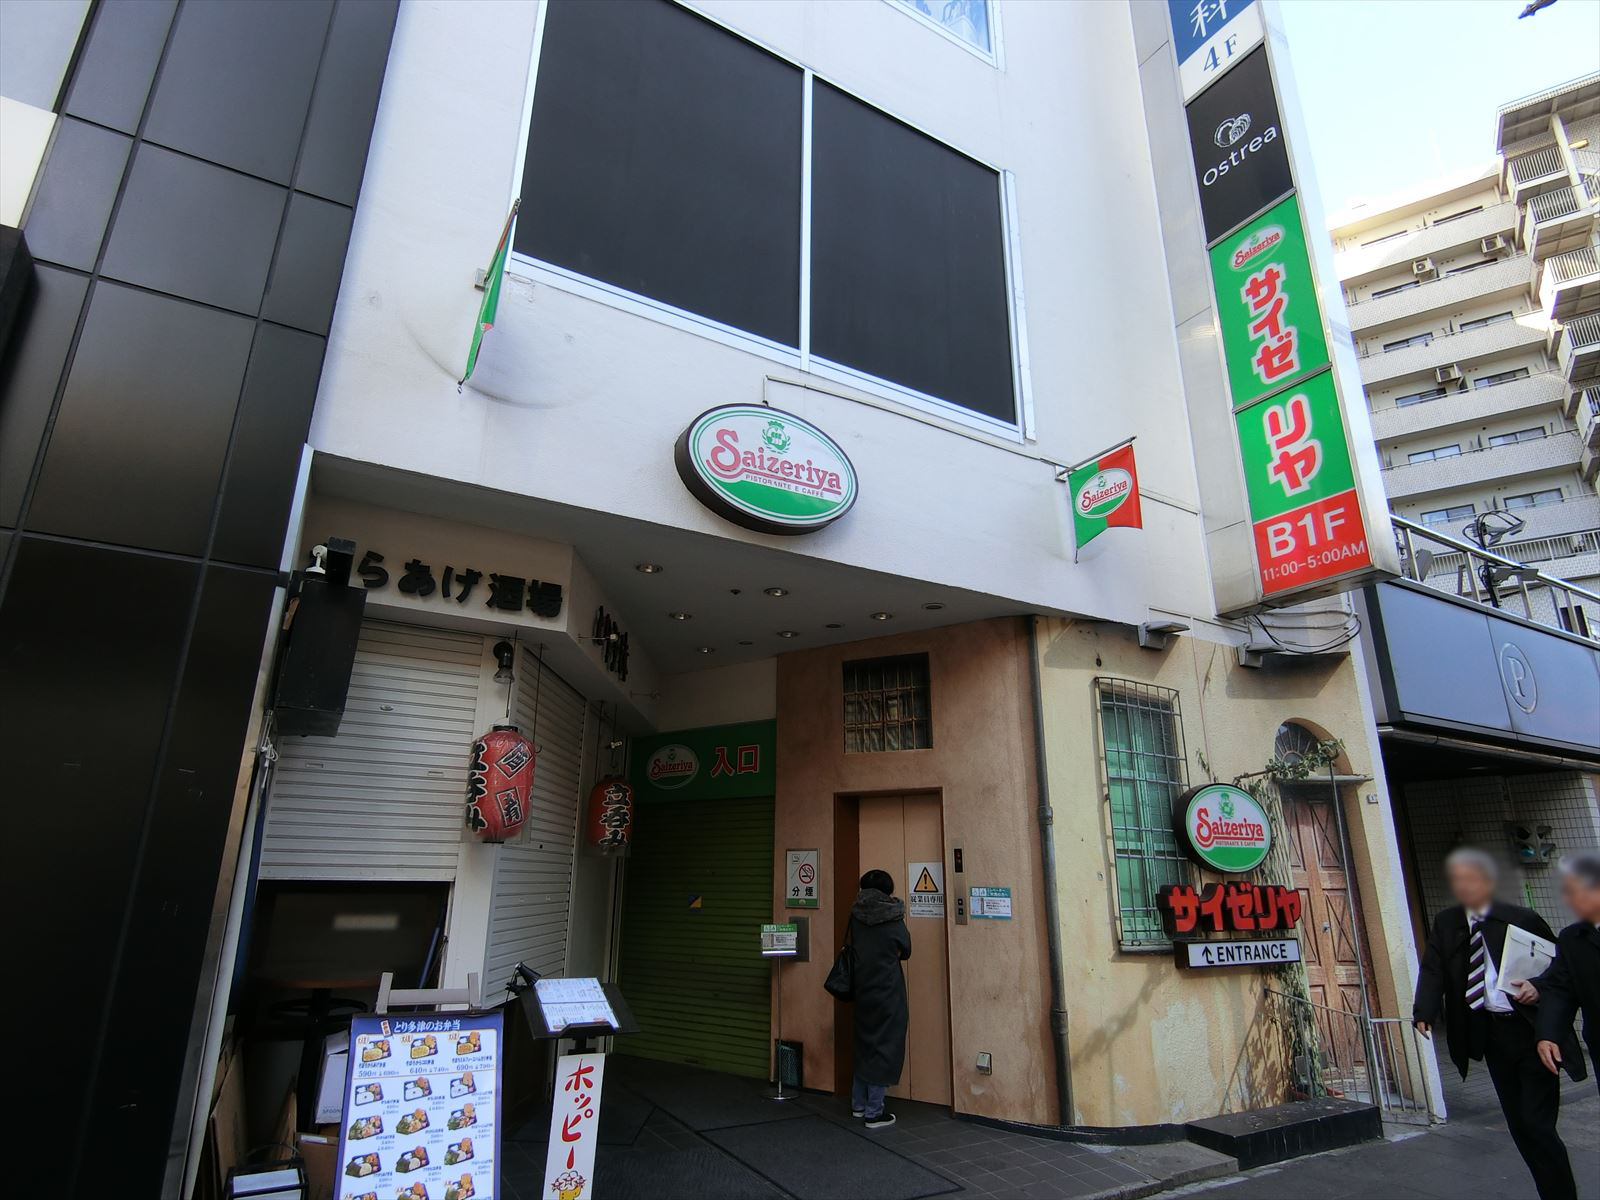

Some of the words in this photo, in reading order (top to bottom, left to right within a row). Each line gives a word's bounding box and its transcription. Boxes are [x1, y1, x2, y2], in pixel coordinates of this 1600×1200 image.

[1203, 33, 1237, 72] 4F
[1203, 125, 1277, 186] ostrea
[1233, 232, 1281, 268] Saizeriya
[706, 428, 842, 496] Saizeriya
[1081, 480, 1128, 512] Saizeriya
[1266, 508, 1345, 559] B1F
[650, 758, 693, 780] Saizeriya
[710, 744, 760, 778] 入口
[1196, 808, 1265, 847] Saizeriya
[792, 886, 814, 897] 分煙
[1168, 882, 1301, 933] サイゼリヤ
[1217, 943, 1288, 963] ENTRANCE
[393, 1019, 461, 1033] とり多津のお弁当
[561, 1058, 594, 1170] ホッピー
